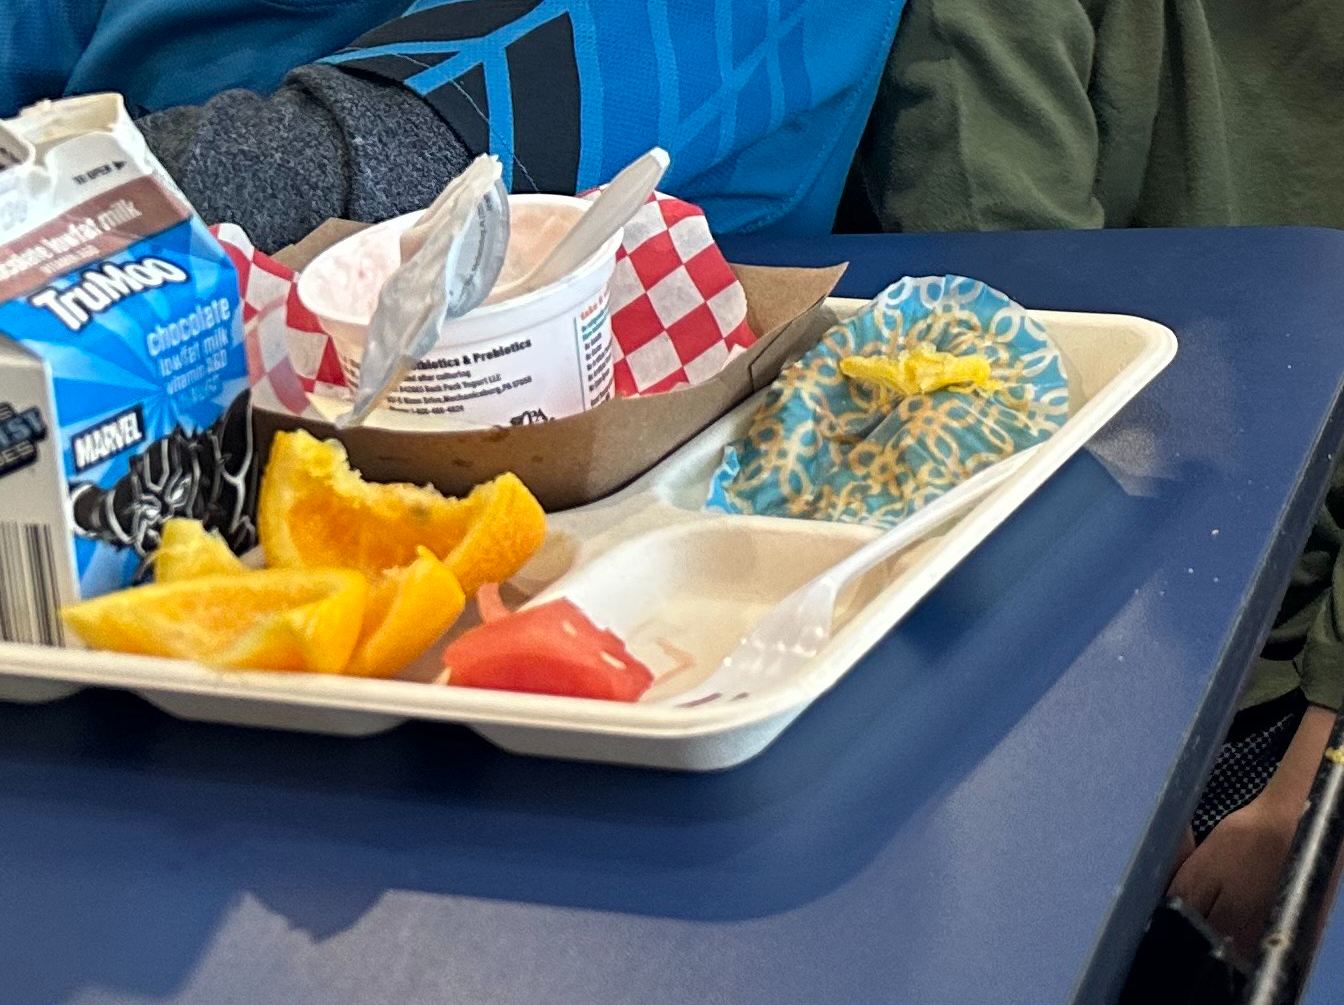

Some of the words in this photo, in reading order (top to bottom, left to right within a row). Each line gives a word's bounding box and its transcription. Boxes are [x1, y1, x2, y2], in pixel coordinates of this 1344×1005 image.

[98, 198, 142, 232] milk
[31, 257, 188, 331] TruMoo
[147, 297, 231, 356] chocolate
[160, 341, 200, 377] lowfat
[203, 326, 229, 354] milk
[462, 354, 471, 365] &
[473, 339, 532, 363] Probiotics
[74, 412, 142, 469] MARVEL
